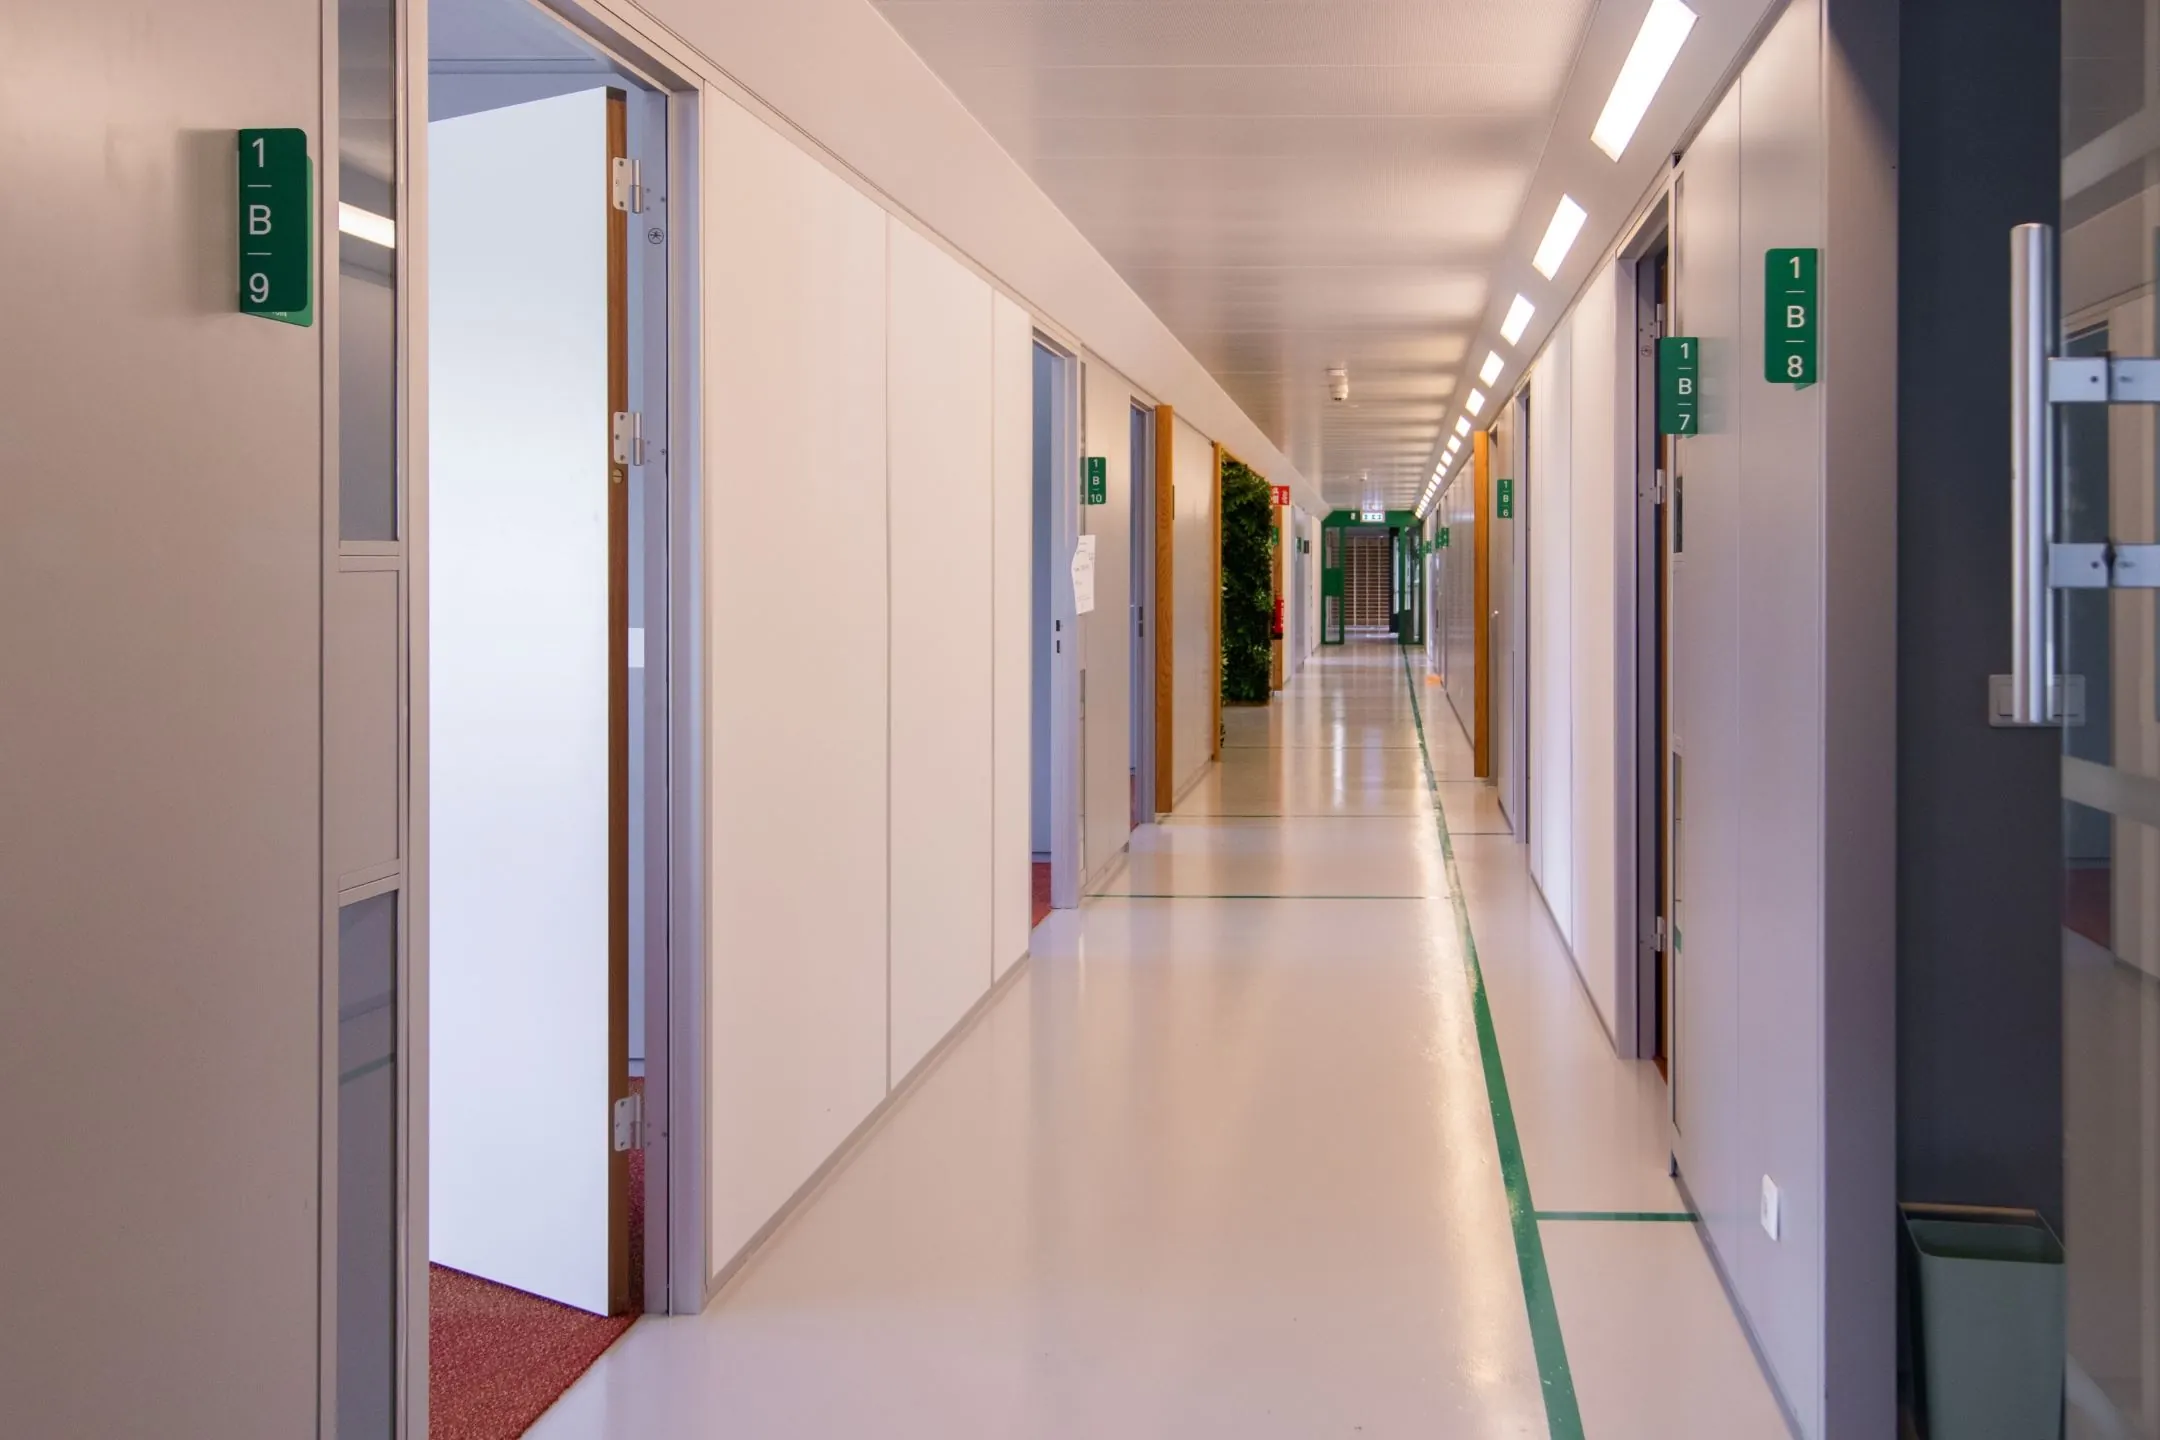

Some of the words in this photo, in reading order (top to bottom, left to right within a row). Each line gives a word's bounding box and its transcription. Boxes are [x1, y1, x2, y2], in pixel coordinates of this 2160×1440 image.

[251, 137, 264, 168] 1
[249, 204, 272, 235] B
[1789, 256, 1800, 279] 1
[249, 272, 270, 304] 9
[1786, 305, 1805, 328] B
[1680, 342, 1689, 359] 1
[1787, 355, 1803, 378] 8
[1678, 377, 1692, 395] B
[1679, 414, 1691, 431] 7
[1093, 458, 1099, 468] 1
[1092, 476, 1101, 485] B
[1091, 494, 1103, 503] 10
